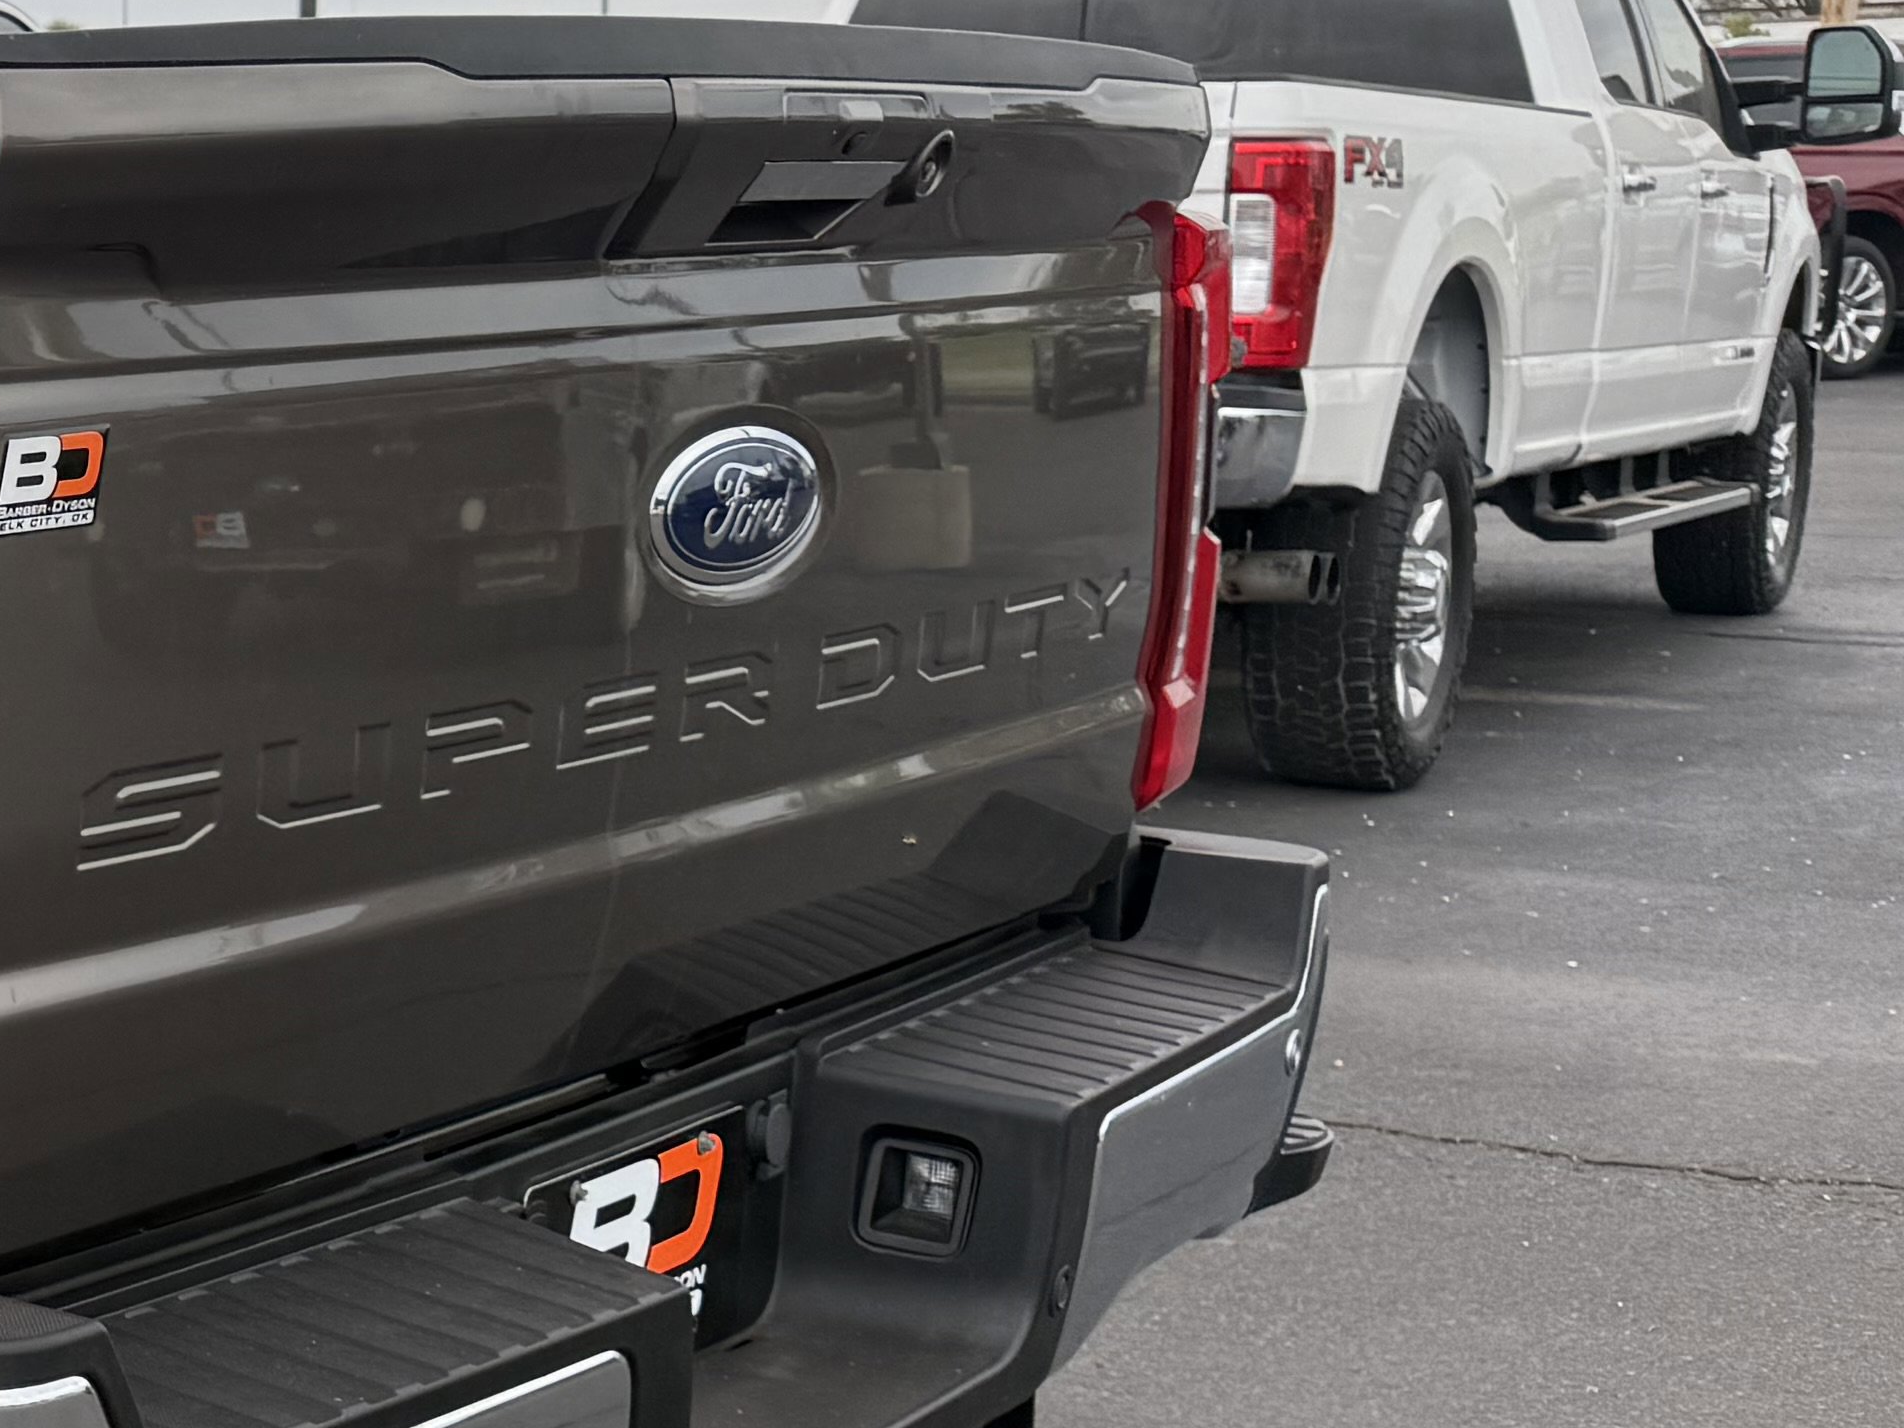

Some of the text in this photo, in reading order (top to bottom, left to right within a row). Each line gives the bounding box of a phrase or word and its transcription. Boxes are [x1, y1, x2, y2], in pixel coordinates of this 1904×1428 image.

[72, 512, 90, 522] OK
[703, 461, 795, 550] Ford
[75, 567, 1132, 872] SUPER DUTY
